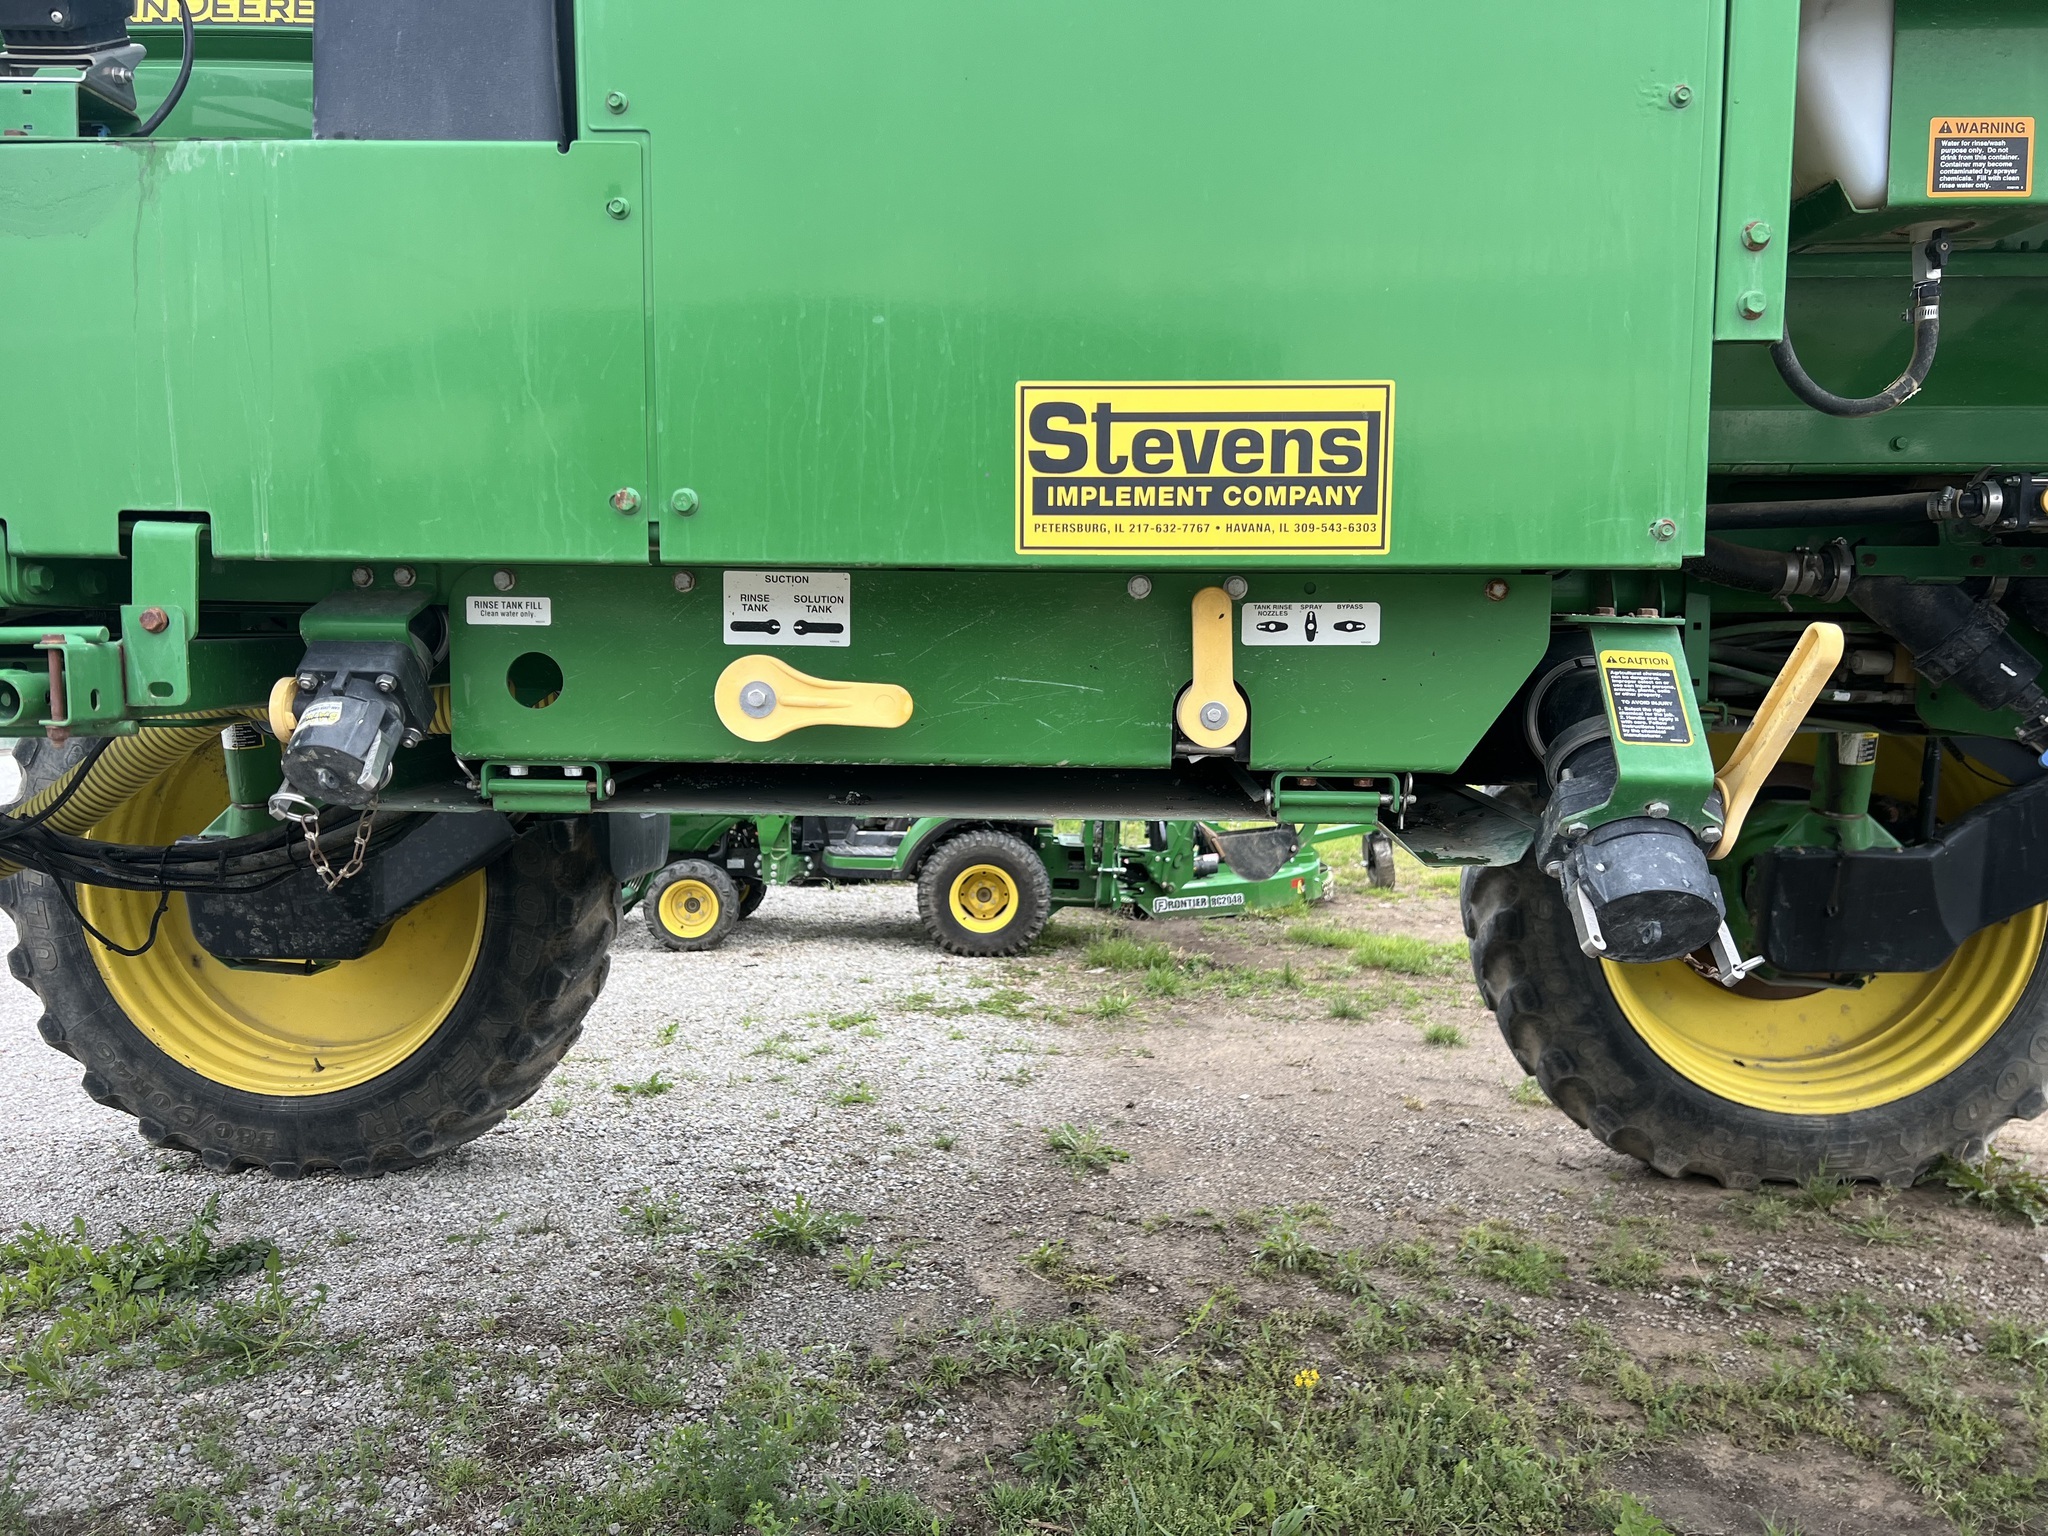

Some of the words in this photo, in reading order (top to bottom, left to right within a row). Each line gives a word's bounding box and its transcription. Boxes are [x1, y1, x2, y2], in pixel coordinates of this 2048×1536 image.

[1956, 122, 2025, 133] WARNING
[1028, 402, 1363, 474] Stevens
[1047, 486, 1213, 506] IMPLEMENT
[1222, 485, 1363, 506] COMPANY
[1034, 523, 1110, 535] PETERSBURG,
[1114, 523, 1124, 533] IL
[1129, 523, 1210, 533] 217-632-7767
[1226, 523, 1275, 535] HAVANA,
[1279, 523, 1289, 533] IL
[1294, 523, 1377, 533] 309-543-6303
[765, 575, 809, 583] SUCTION
[740, 594, 770, 602] RINSE
[794, 595, 844, 604] SOLUTION
[474, 601, 498, 609] RINSE
[501, 601, 523, 609] TANK
[742, 604, 768, 612] TANK
[806, 605, 832, 613] TANK
[1618, 656, 1669, 665] CAUTION
[1154, 898, 1207, 912] FRONTIER
[1211, 895, 1242, 906] RC2048
